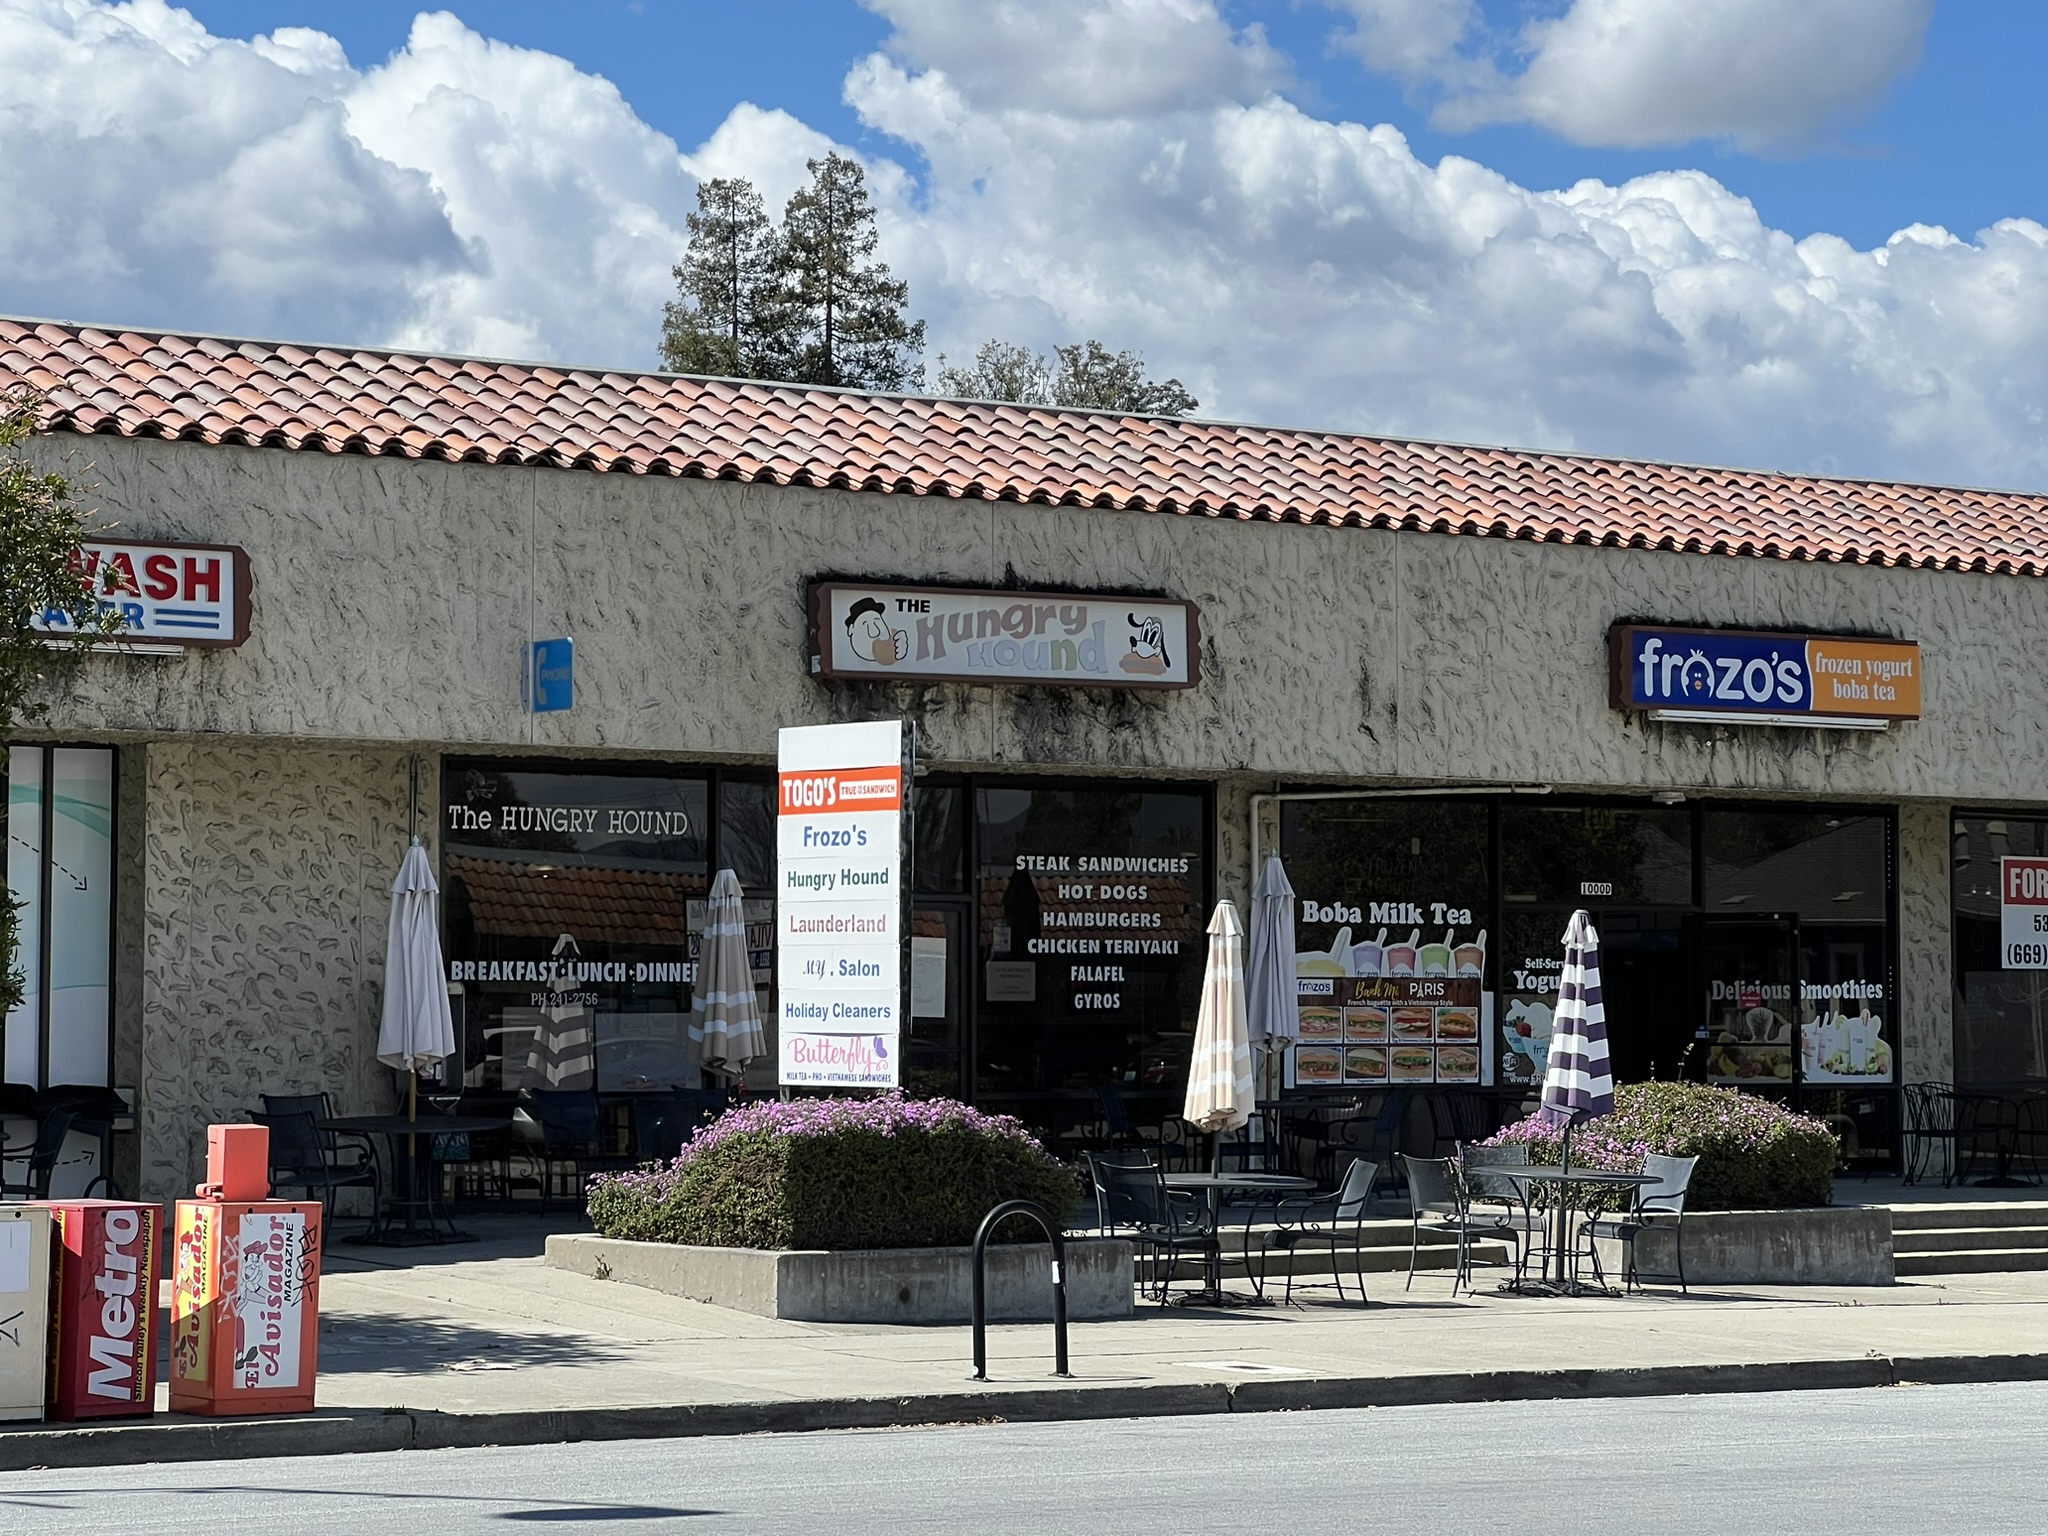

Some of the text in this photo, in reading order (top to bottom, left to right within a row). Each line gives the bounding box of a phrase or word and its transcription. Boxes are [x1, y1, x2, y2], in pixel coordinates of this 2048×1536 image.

[896, 599, 930, 613] THE
[916, 604, 1087, 662] Hungry
[1815, 652, 1912, 681] frozen yogurt
[1833, 679, 1896, 700] boba tea
[782, 777, 836, 807] TOGO'S
[841, 786, 857, 795] TRUE
[863, 784, 895, 794] SANDWICH
[449, 806, 688, 836] The HUNGRY HOUND
[803, 825, 867, 847] Frozo's
[1016, 855, 1189, 873] STEAK SANDWICHES
[788, 868, 889, 891] Hungry Hound
[2010, 868, 2048, 899] FOR
[1058, 885, 1148, 900] HOT DOGS
[790, 914, 886, 933] Launderland
[1043, 912, 1161, 927] HAMBURGERS
[1302, 901, 1472, 924] Boba Milk Tea
[1028, 939, 1179, 954] CHICKEN TERIYAKI
[2007, 943, 2048, 966] (669)
[451, 960, 559, 982] BREAKFAST
[567, 962, 626, 982] LUNCH
[839, 959, 880, 976] Salon
[1071, 966, 1125, 982] FALAFEL
[1525, 958, 1564, 969] Self-Serv
[1513, 970, 1560, 993] Yogu
[786, 1003, 891, 1021] Holiday Cleaners
[1074, 993, 1120, 1009] GYROS
[788, 1036, 888, 1076] Butterfly
[786, 1072, 798, 1080] MILK
[799, 1072, 807, 1080] TEA
[827, 1073, 857, 1082] VIETNAMESE
[200, 1215, 208, 1294] MAGAZINE
[284, 1222, 294, 1302] MAGAZINE
[187, 1207, 203, 1369] Avisador
[259, 1215, 285, 1377] Avisador
[88, 1210, 139, 1400] Metro
[134, 1211, 152, 1400] Silicon Valley's Weekly Newspaper
[245, 1361, 260, 1389] El
